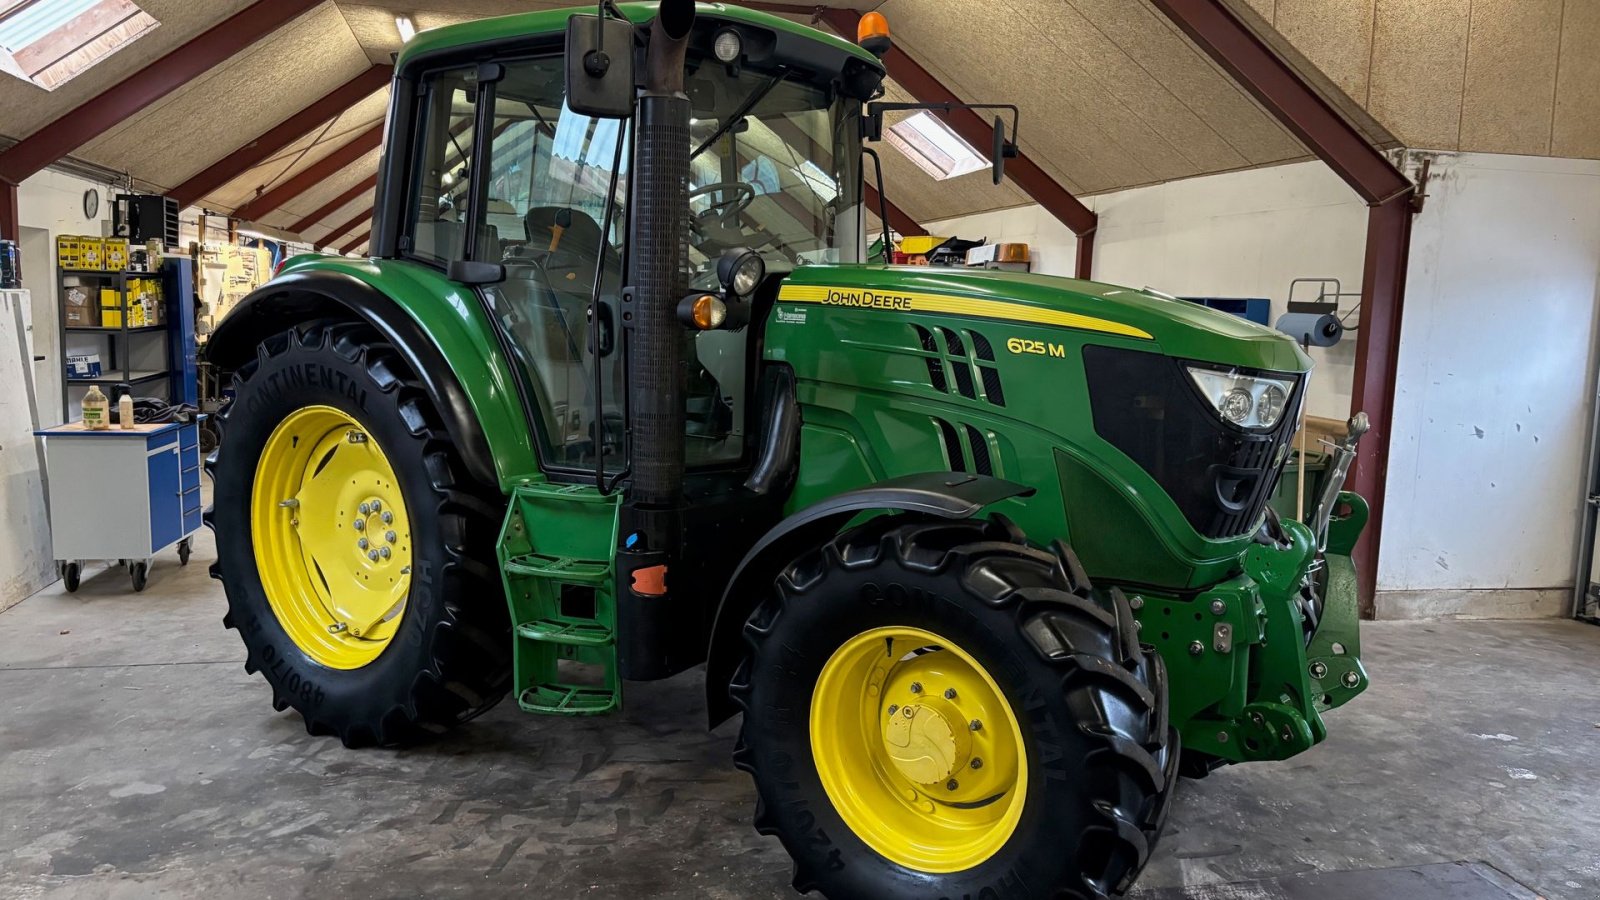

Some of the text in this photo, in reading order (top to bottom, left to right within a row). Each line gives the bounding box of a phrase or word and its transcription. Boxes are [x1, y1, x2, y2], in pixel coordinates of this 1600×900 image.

[822, 289, 913, 309] JOHN DEERE
[1007, 338, 1066, 358] 6125 M
[262, 644, 326, 705] 480/70
